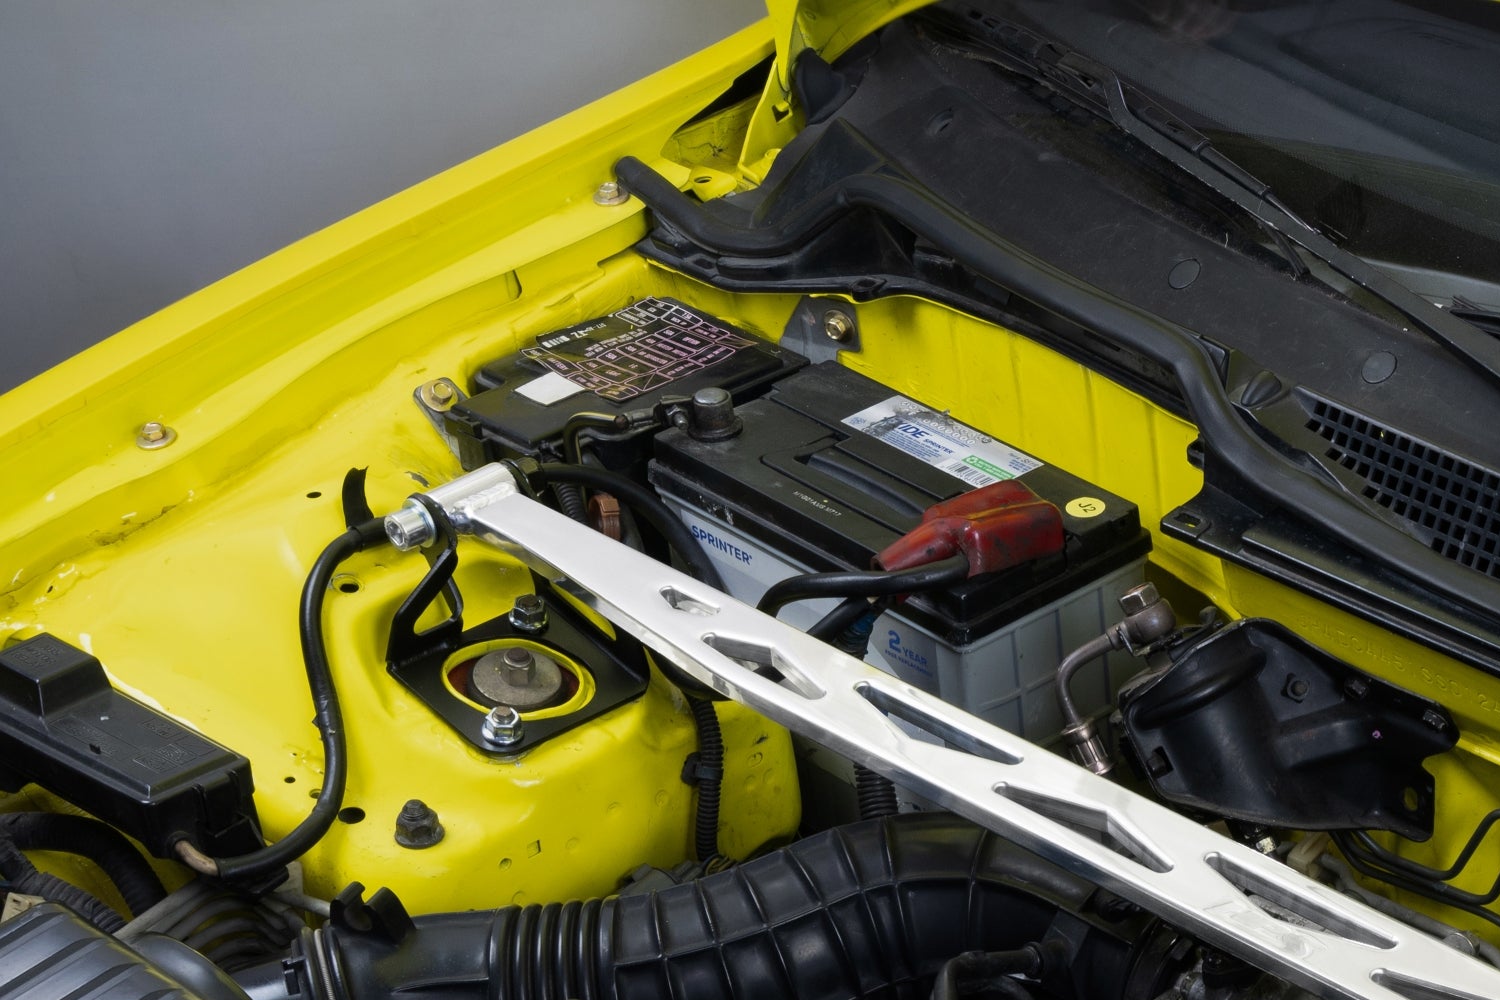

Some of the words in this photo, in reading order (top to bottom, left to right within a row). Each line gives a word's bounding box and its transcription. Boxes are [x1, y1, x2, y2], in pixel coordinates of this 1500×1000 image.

[691, 525, 751, 566] SPRINTER
[887, 629, 902, 654] 2
[902, 646, 928, 665] YEAR
